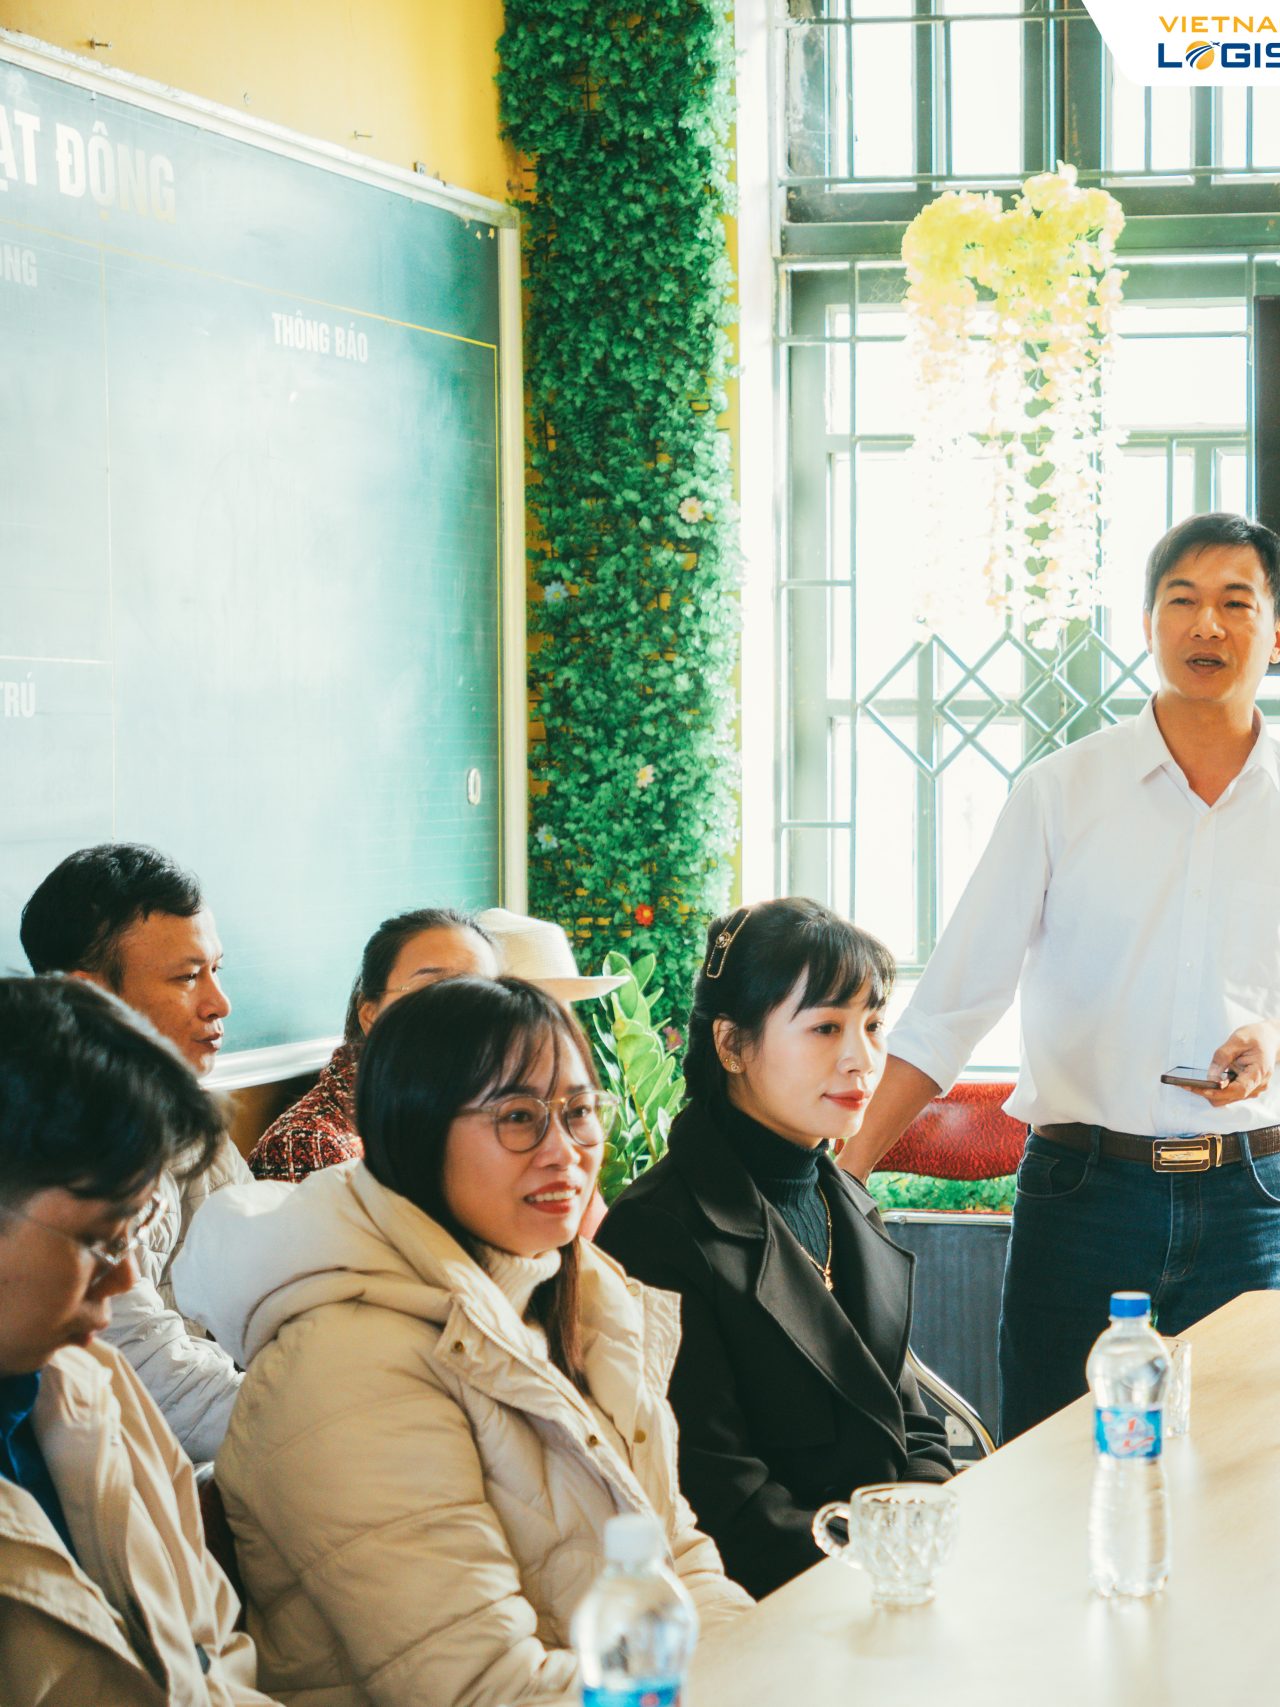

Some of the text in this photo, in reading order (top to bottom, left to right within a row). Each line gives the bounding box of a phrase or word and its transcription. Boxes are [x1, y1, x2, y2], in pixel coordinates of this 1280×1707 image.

[55, 120, 176, 225] ĐỘNG
[0, 243, 38, 288] NG
[271, 310, 369, 363] THÔNG BÁO
